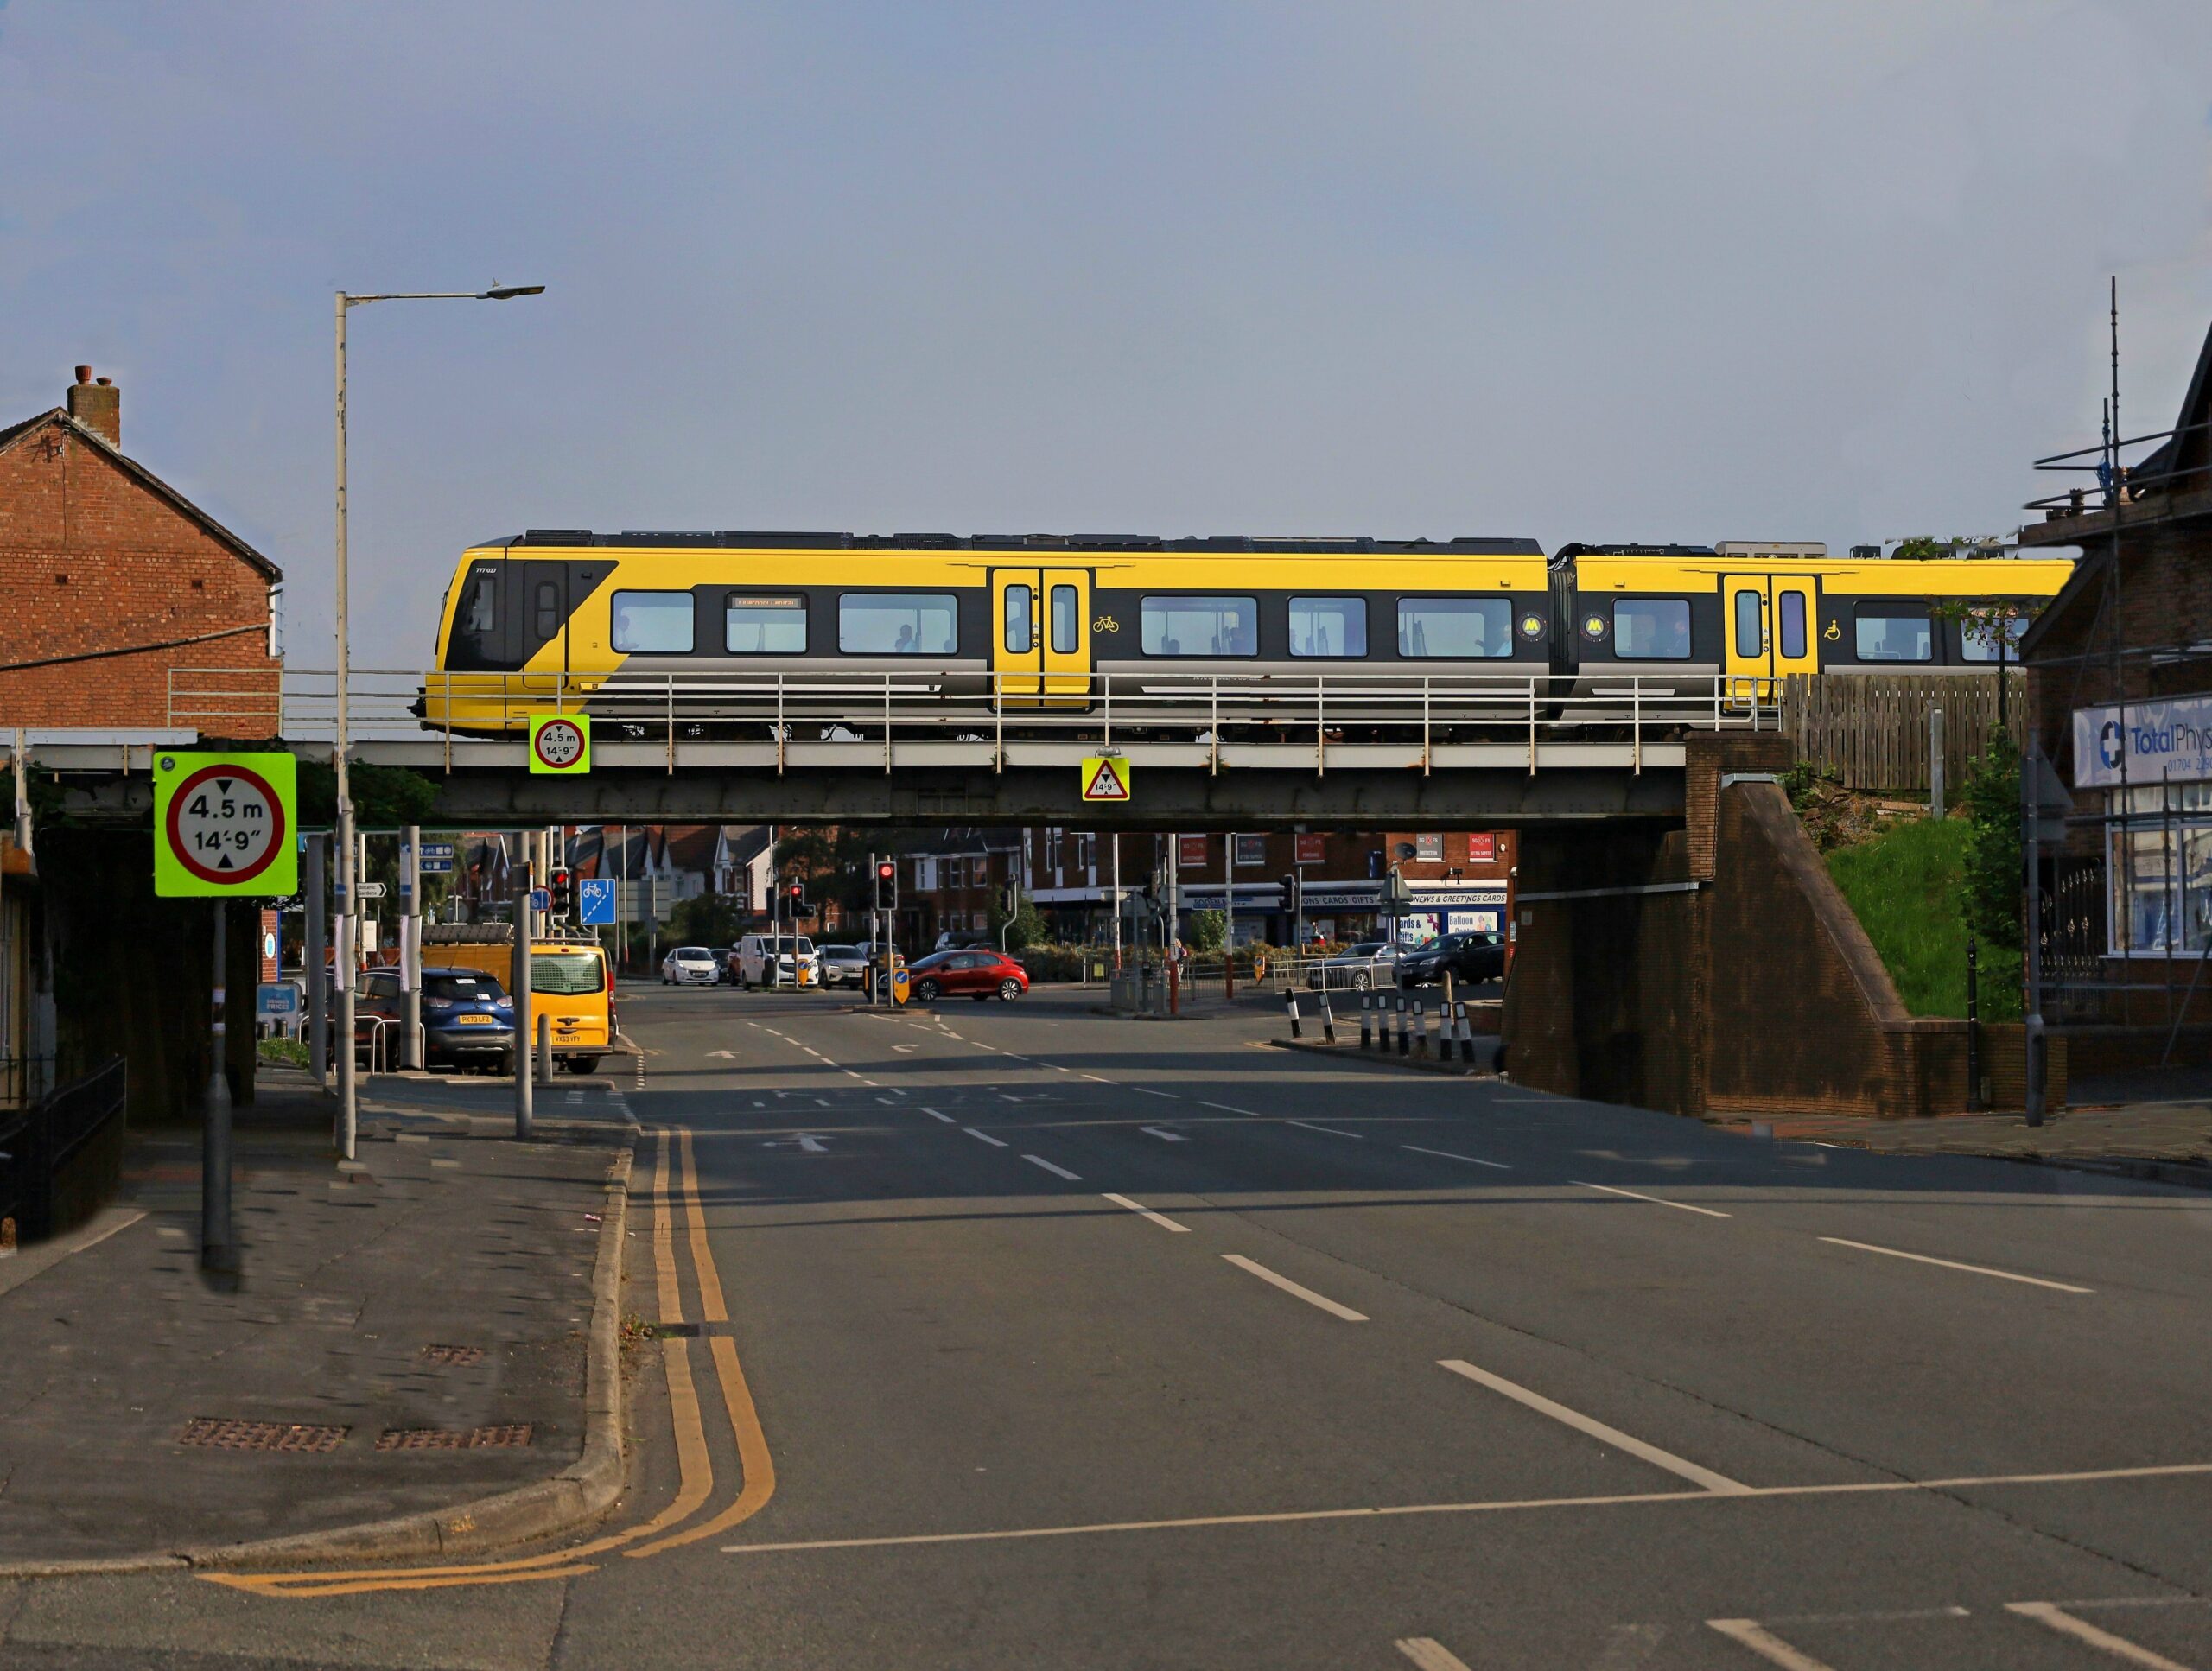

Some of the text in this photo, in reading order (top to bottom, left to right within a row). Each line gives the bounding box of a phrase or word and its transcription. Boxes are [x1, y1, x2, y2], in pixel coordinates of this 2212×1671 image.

[543, 732, 564, 742] 4.5
[2167, 759, 2191, 772] 01704
[188, 795, 263, 820] 4.5 m
[1322, 895, 1348, 905] CARDS
[1351, 894, 1374, 904] GIFTS
[1442, 894, 1481, 903] GREETINGS
[1399, 918, 1421, 929] ards &
[1449, 915, 1473, 925] Balloon
